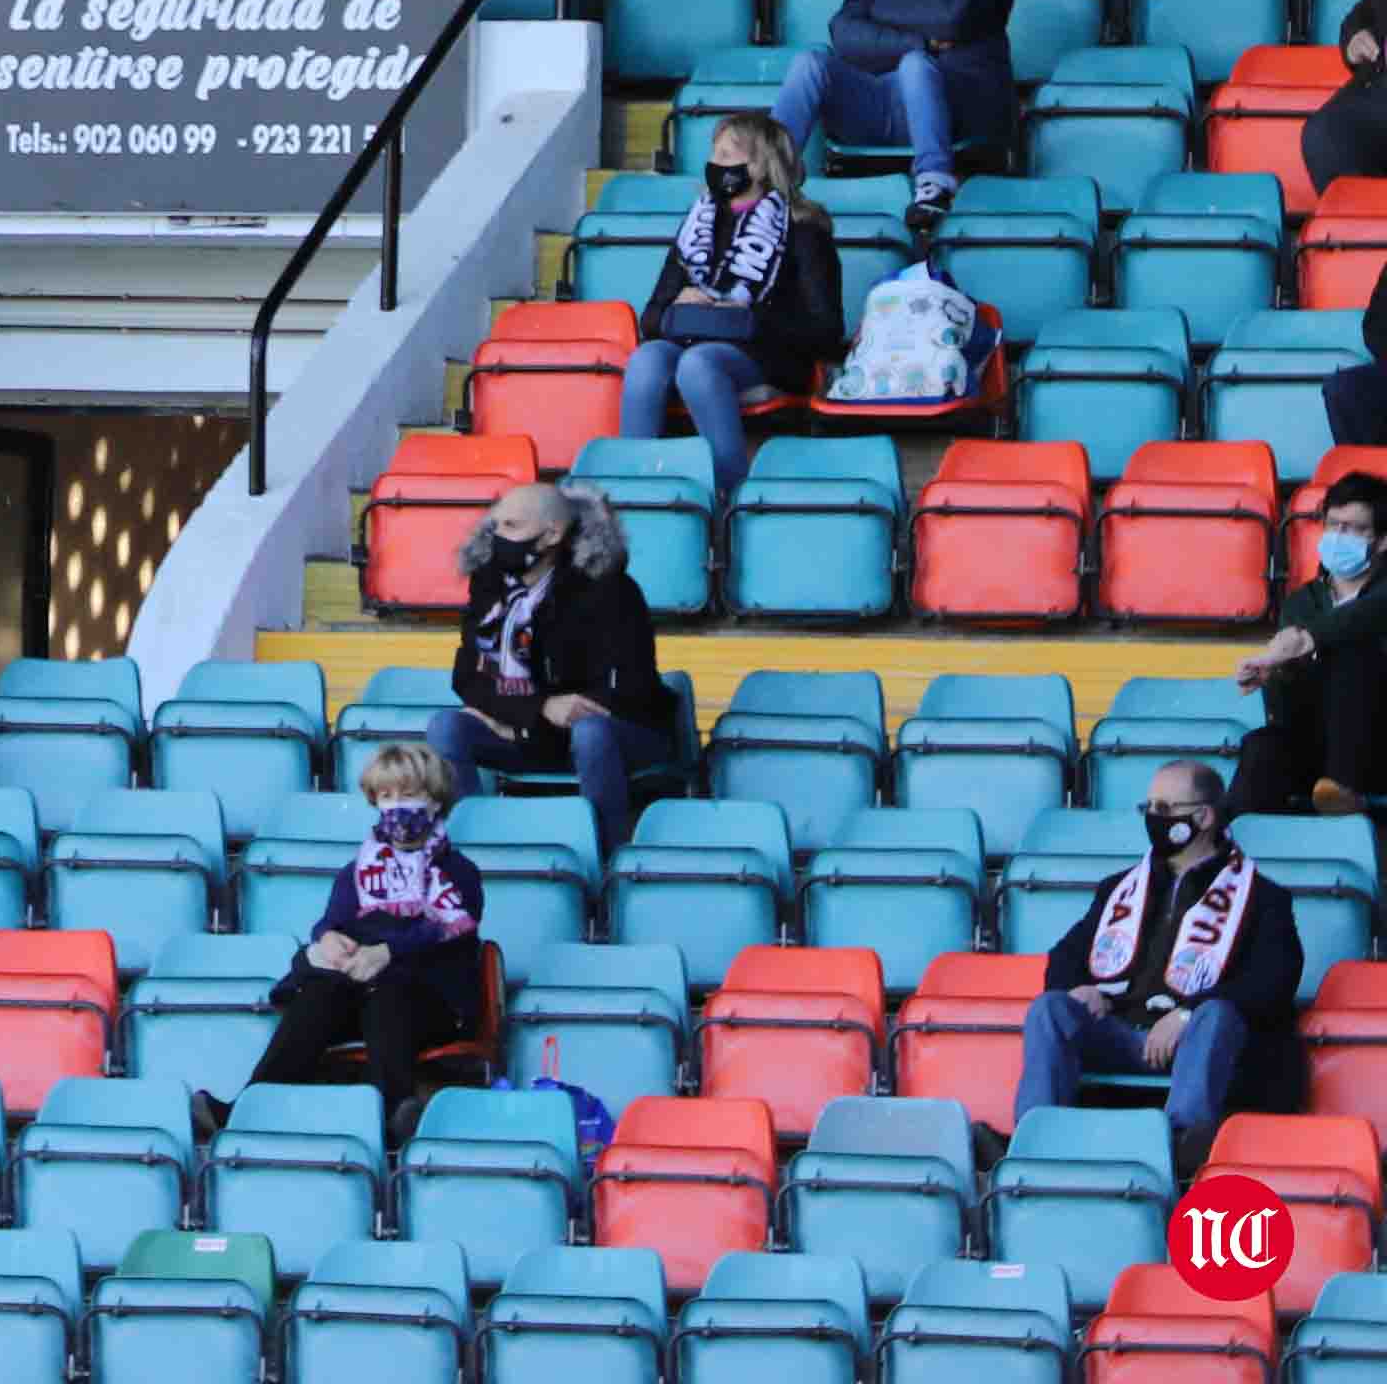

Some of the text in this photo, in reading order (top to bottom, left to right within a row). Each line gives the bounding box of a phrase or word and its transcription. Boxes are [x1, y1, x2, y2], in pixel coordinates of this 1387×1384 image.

[6, 123, 67, 154] Tels.:
[74, 125, 122, 154] 902
[129, 125, 177, 154] 060
[184, 125, 217, 154] 99
[252, 125, 301, 154] 923
[308, 125, 352, 154] 221
